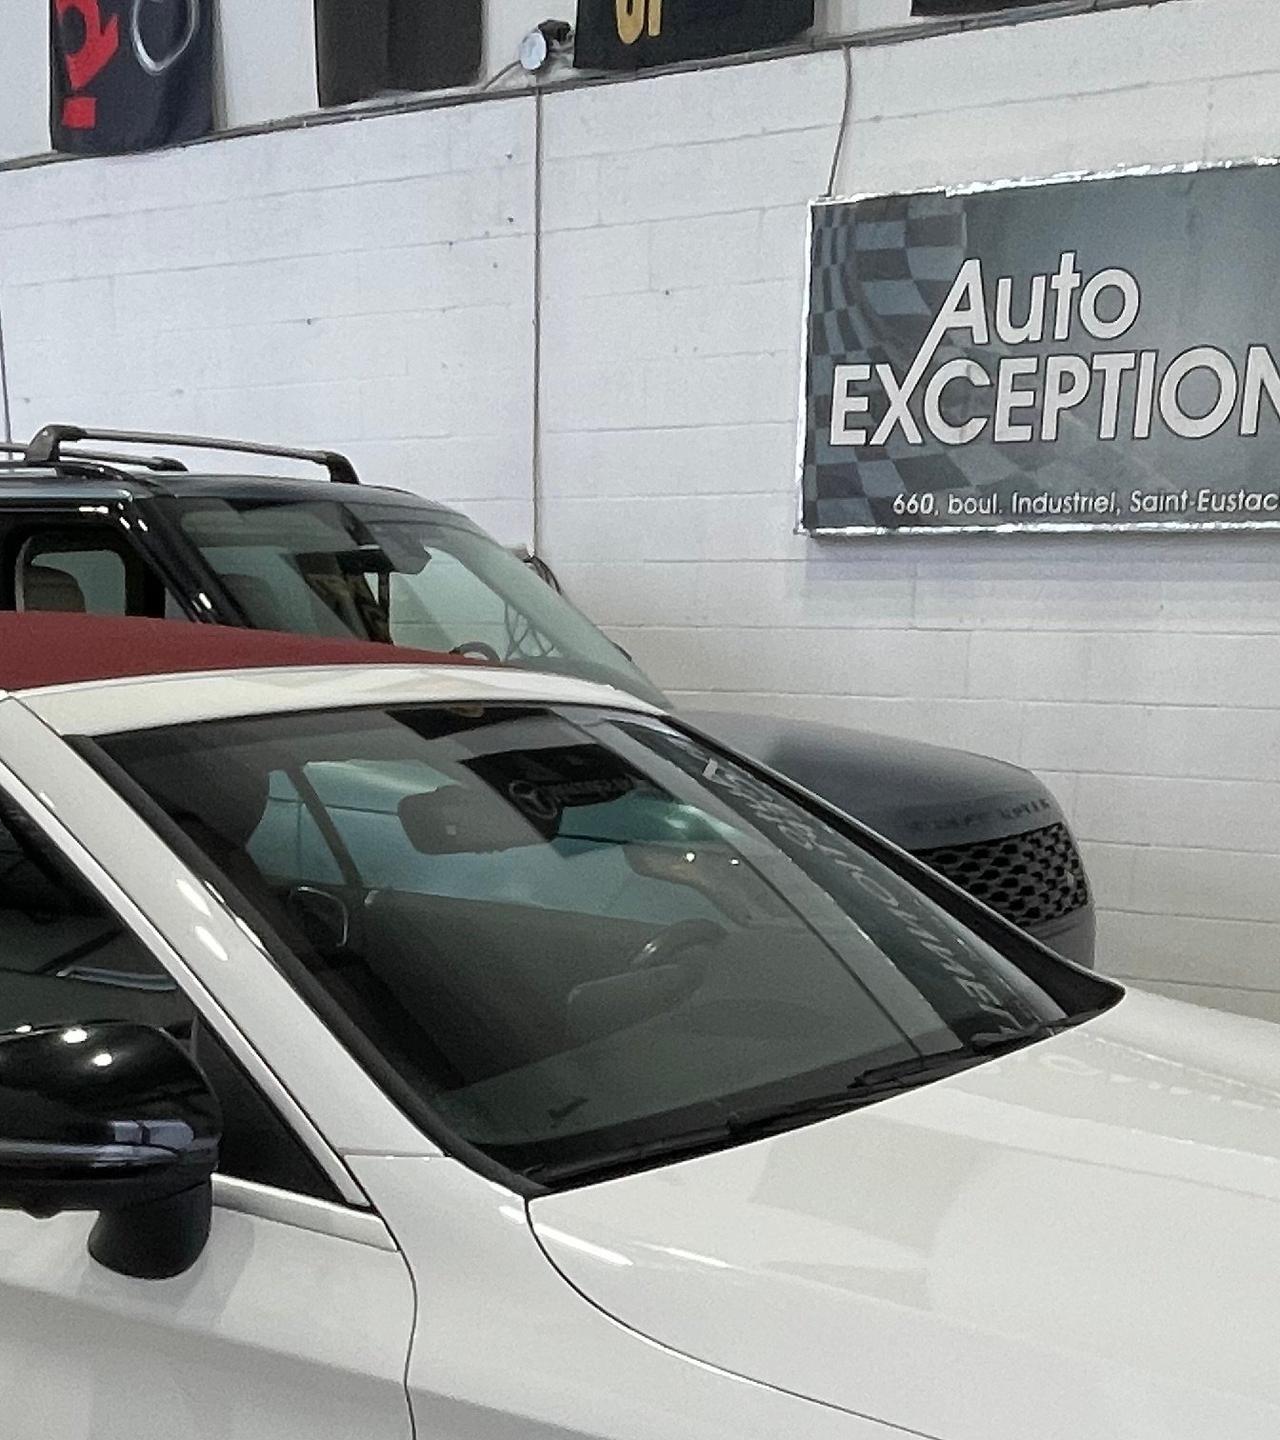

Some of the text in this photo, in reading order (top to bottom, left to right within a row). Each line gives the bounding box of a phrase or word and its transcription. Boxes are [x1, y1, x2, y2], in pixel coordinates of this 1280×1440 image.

[923, 251, 1142, 345] Auto
[892, 492, 940, 517] 660,
[947, 492, 1004, 515] boul.
[1011, 490, 1122, 517] Industriel,
